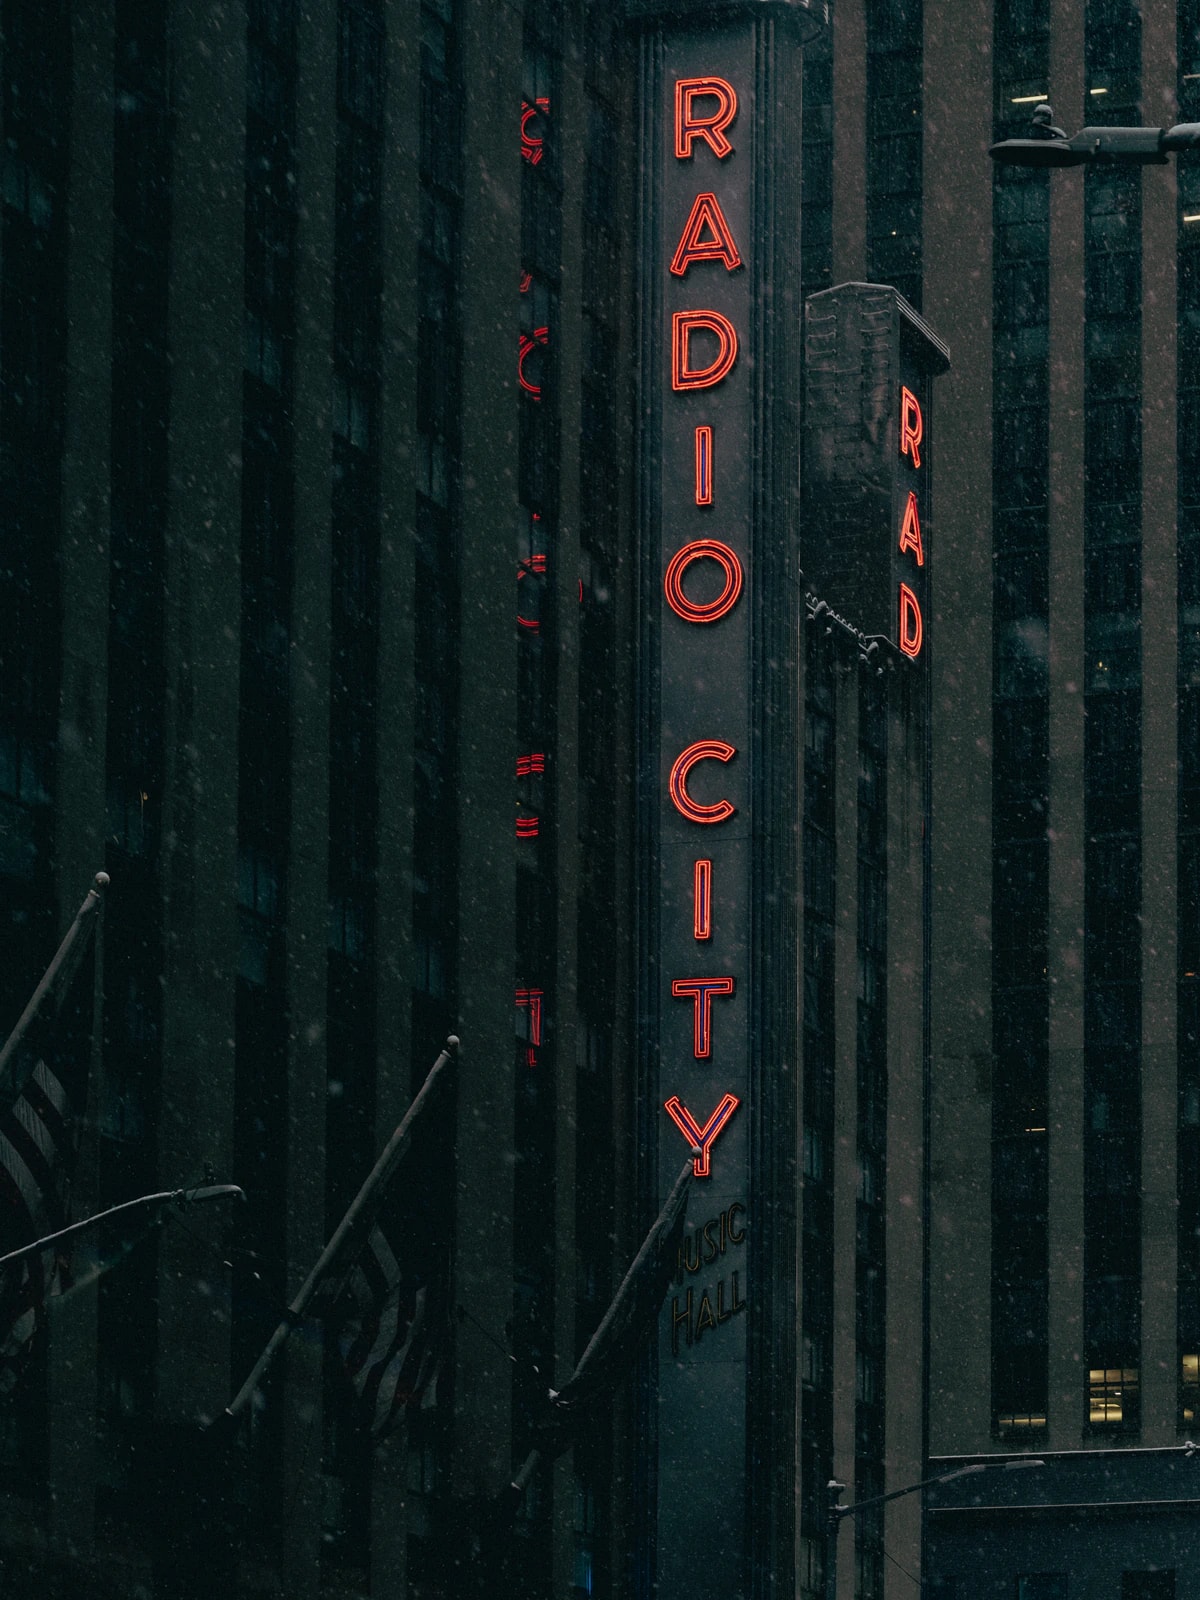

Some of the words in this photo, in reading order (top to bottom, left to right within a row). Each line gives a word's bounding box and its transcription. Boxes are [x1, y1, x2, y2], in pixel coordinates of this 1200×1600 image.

[664, 75, 743, 623] RADIO
[664, 738, 740, 1178] CITY
[672, 1269, 747, 1358] HALL
